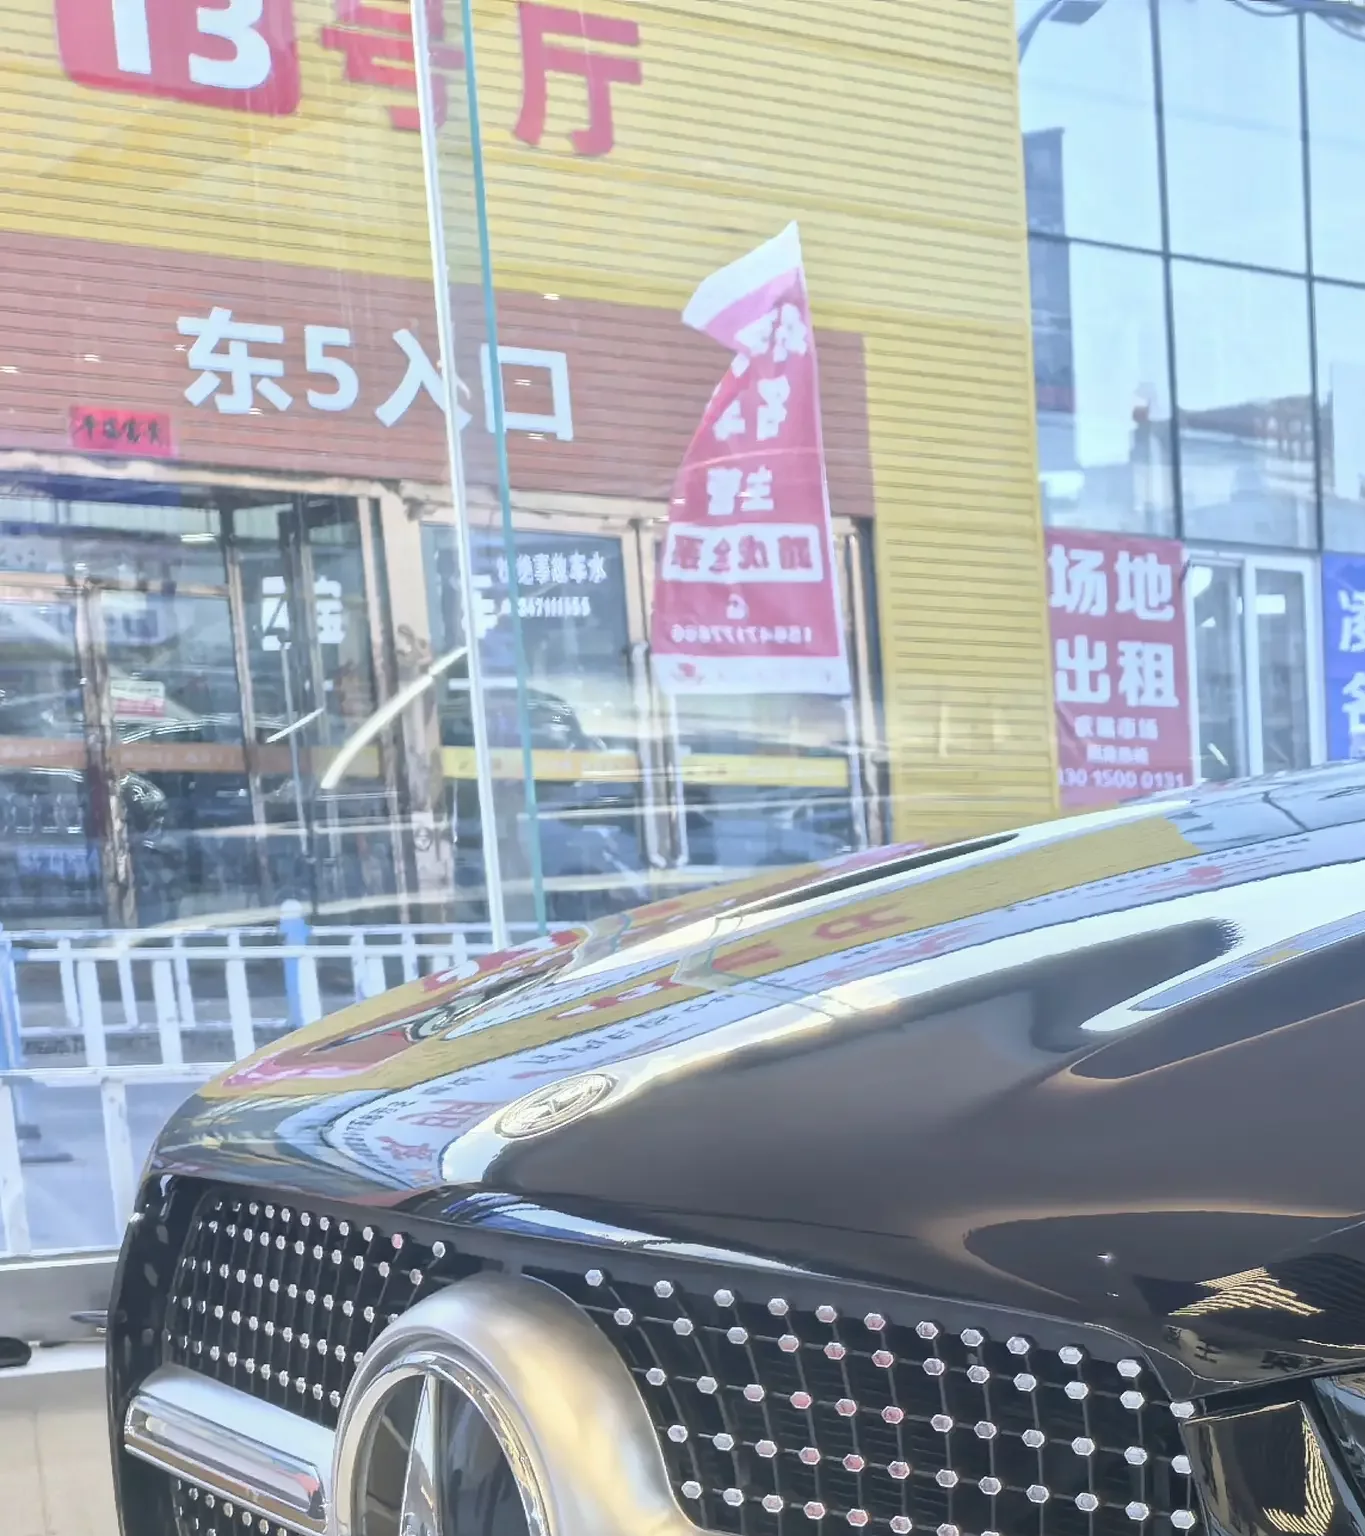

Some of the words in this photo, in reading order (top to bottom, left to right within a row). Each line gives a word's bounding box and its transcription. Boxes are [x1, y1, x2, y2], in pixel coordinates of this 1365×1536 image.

[176, 306, 573, 441] 东5入口
[1048, 544, 1175, 621] 场地
[1055, 635, 1179, 707] 出租
